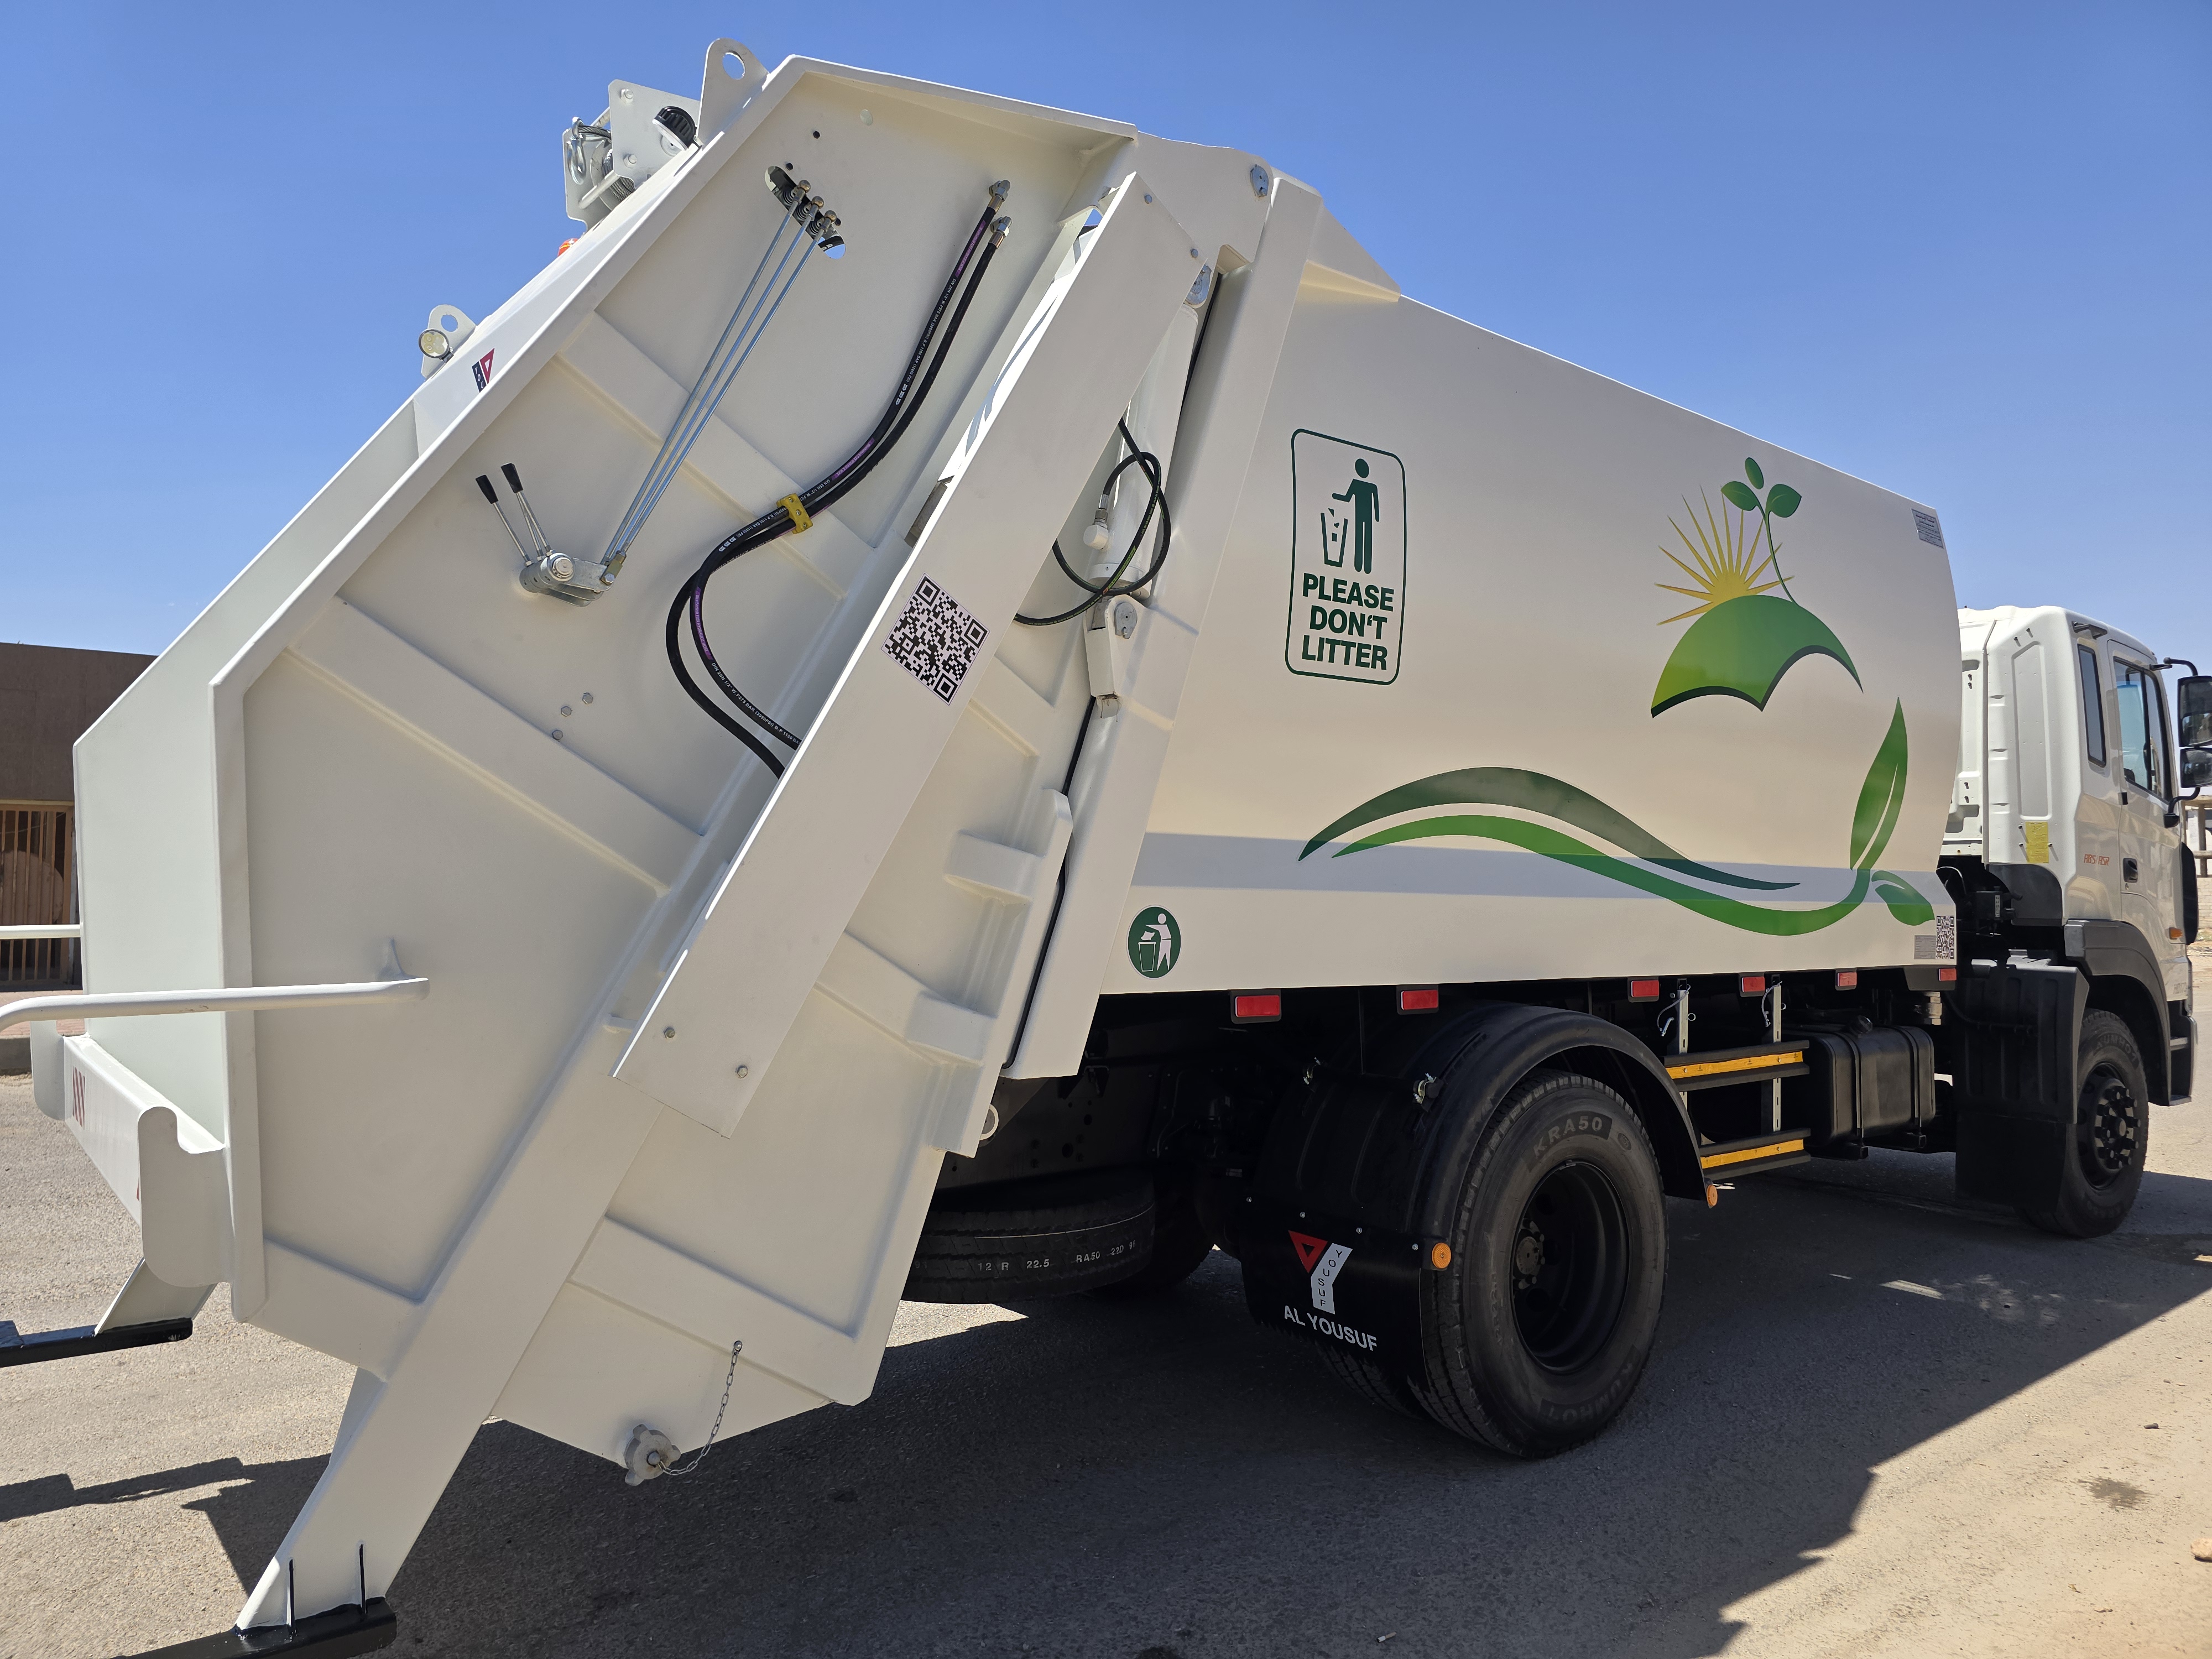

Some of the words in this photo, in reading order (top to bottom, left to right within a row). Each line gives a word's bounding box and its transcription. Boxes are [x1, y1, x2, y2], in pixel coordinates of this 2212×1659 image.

[1302, 572, 1394, 612] PLEASE
[1310, 604, 1387, 639] DON'T
[1302, 635, 1388, 670] LITTER
[745, 703, 755, 712] BAR
[1533, 1115, 1603, 1157] KRA50
[978, 1262, 992, 1271] 12
[1001, 1262, 1009, 1271] R
[1026, 1259, 1050, 1269] 22.5
[1318, 1249, 1343, 1307] YOUSUF
[1284, 1305, 1306, 1326] AL
[1306, 1312, 1378, 1351] YOUSUF
